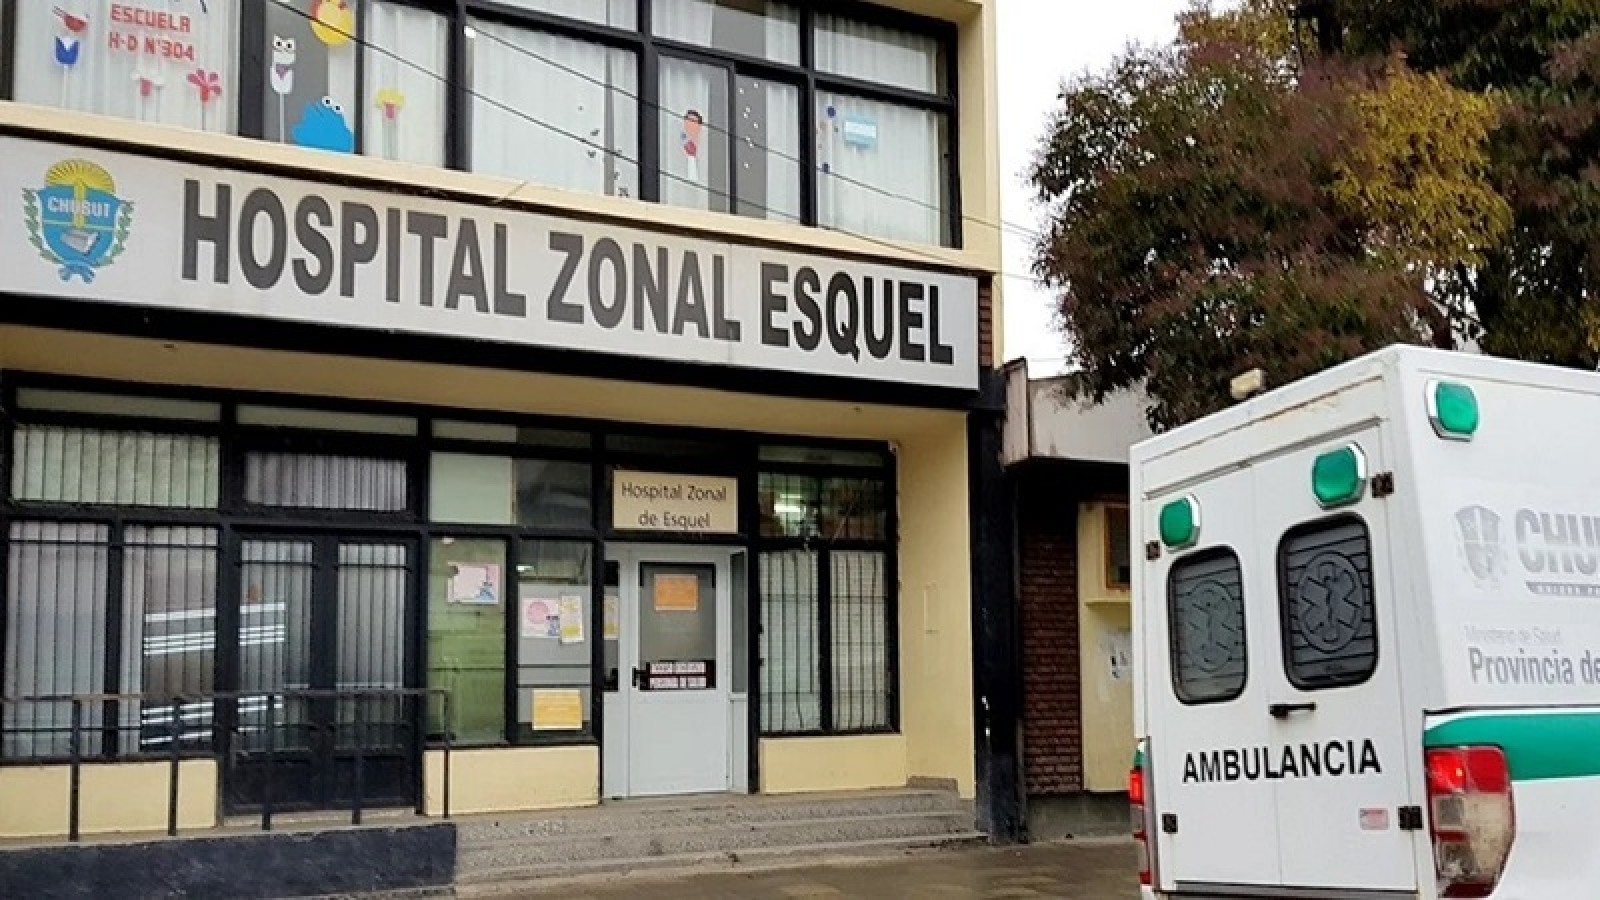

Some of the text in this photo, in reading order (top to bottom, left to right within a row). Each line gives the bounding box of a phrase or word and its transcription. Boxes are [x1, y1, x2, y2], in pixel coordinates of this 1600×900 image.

[110, 4, 191, 32] ESCUELA
[181, 179, 954, 365] HOSPITAL ZONAL ESQUEL
[621, 481, 727, 502] Hospital Zonal
[638, 510, 711, 531] de Esquel
[1468, 646, 1600, 685] Provincia de
[1183, 738, 1382, 784] AMBULANCIA
